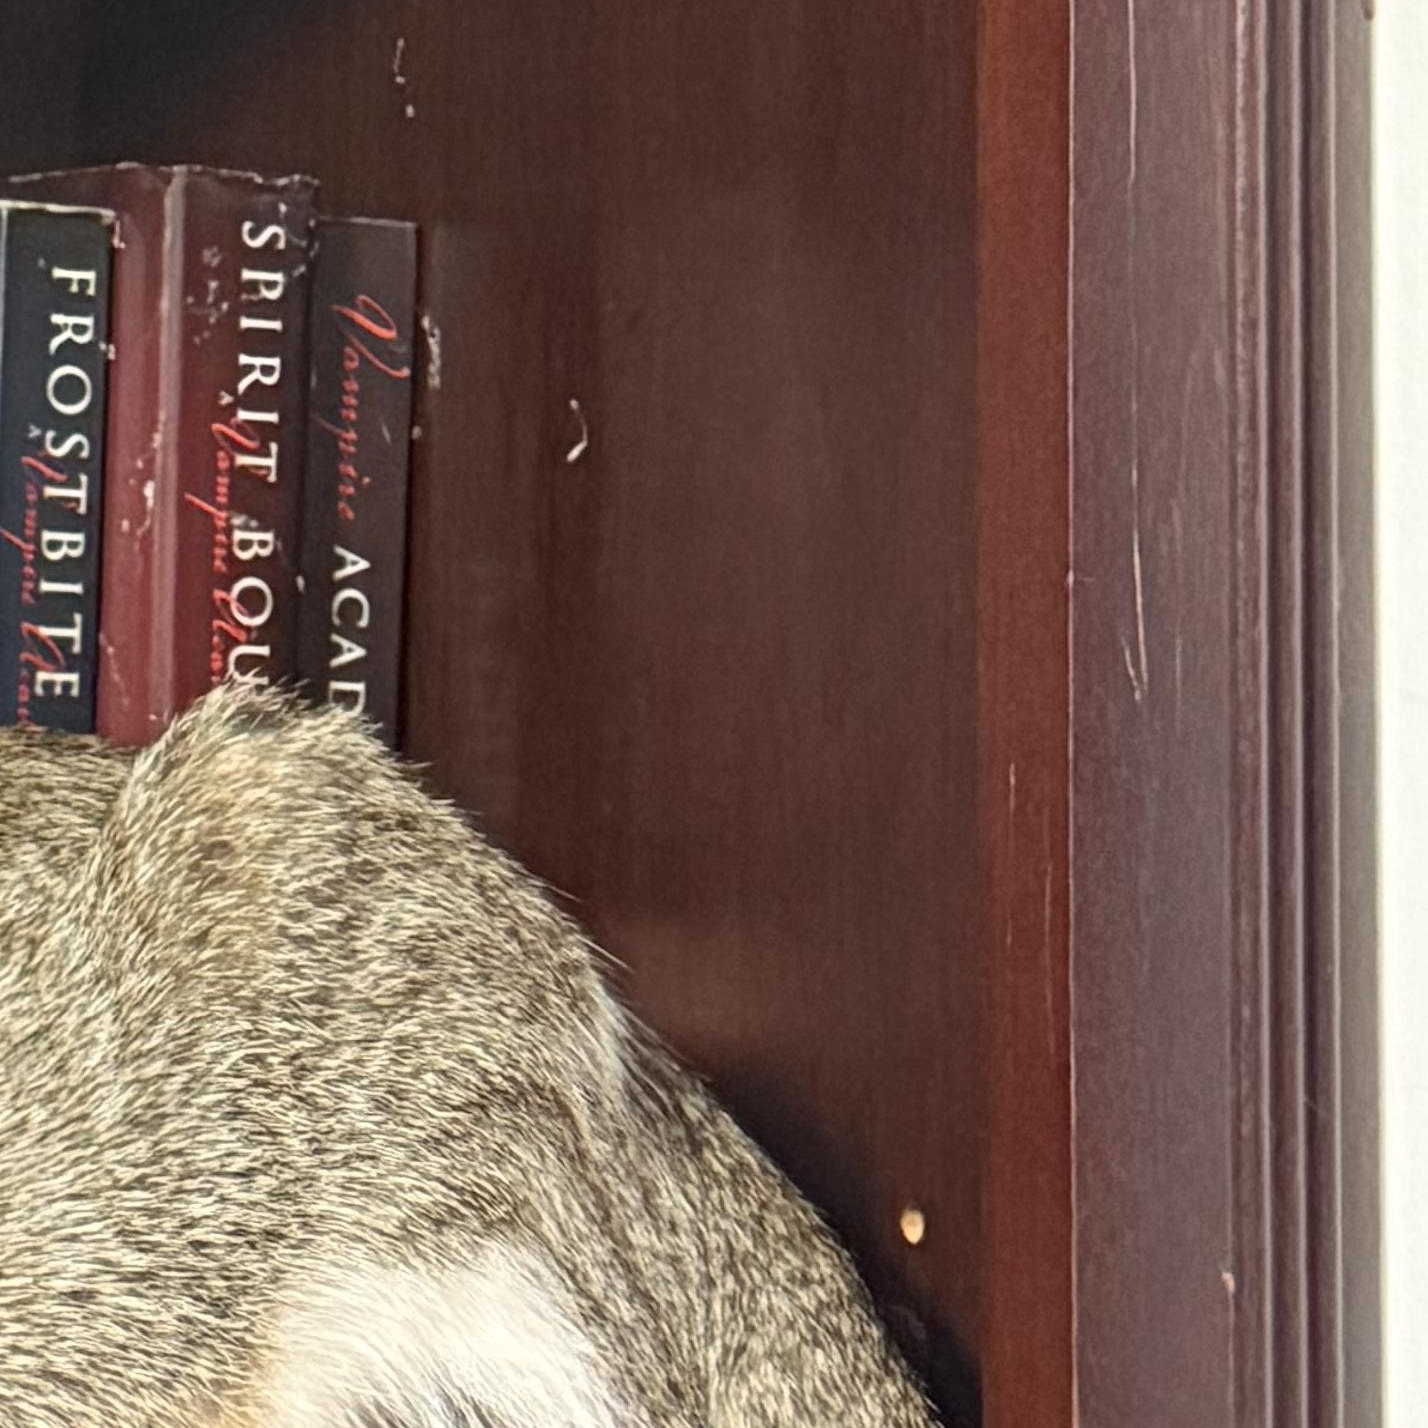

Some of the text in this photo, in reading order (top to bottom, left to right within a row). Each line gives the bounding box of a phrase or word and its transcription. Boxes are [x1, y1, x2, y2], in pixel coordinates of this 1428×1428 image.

[34, 265, 97, 699] FROSTBITE
[230, 219, 287, 688] SPIRIT BOU
[328, 544, 372, 716] ACAD
